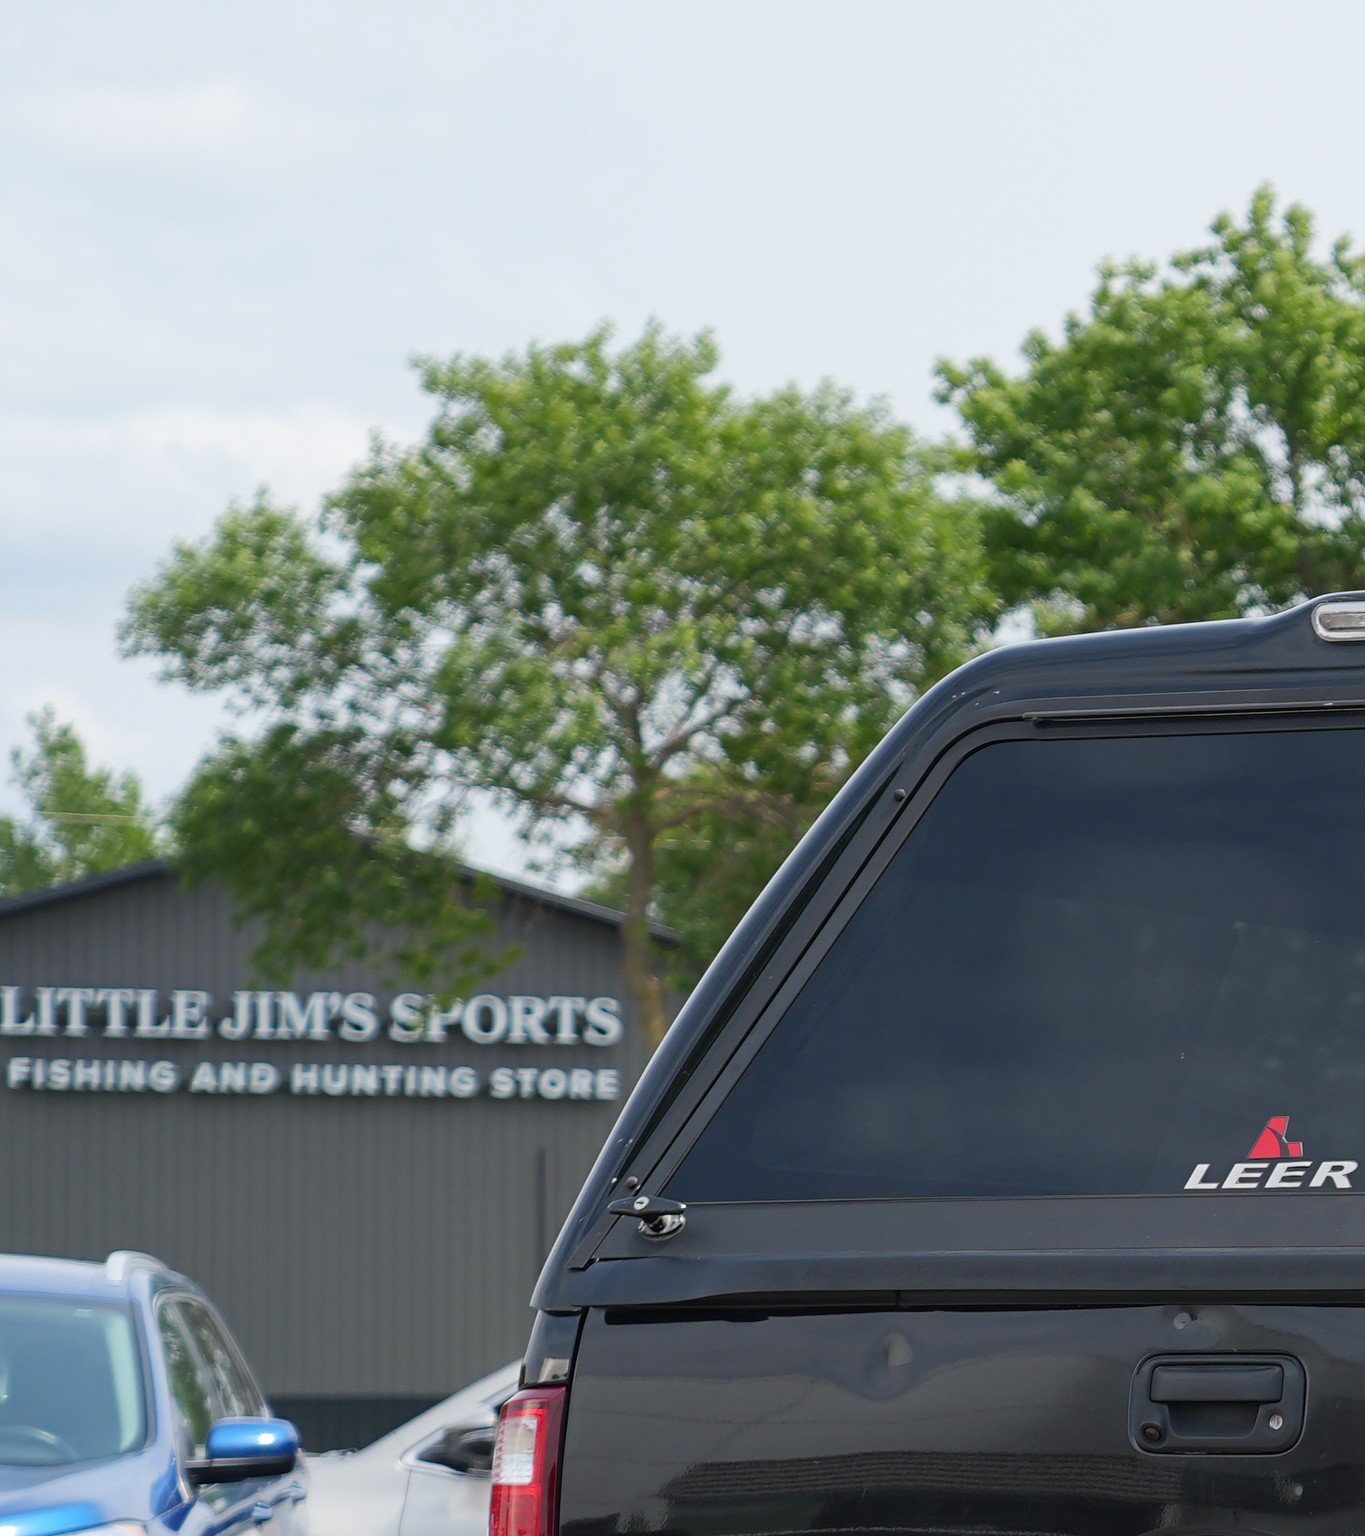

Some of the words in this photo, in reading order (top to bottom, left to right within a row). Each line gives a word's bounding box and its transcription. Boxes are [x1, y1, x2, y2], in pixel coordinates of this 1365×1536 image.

[0, 985, 208, 1041] LITTLE
[220, 991, 379, 1043] JIM'S
[390, 994, 624, 1046] SPORTS
[7, 1057, 178, 1093] FISHING
[190, 1061, 280, 1095] AND
[291, 1063, 477, 1099] HUNTING
[490, 1067, 621, 1100] STORE
[1184, 1161, 1358, 1189] LEER
